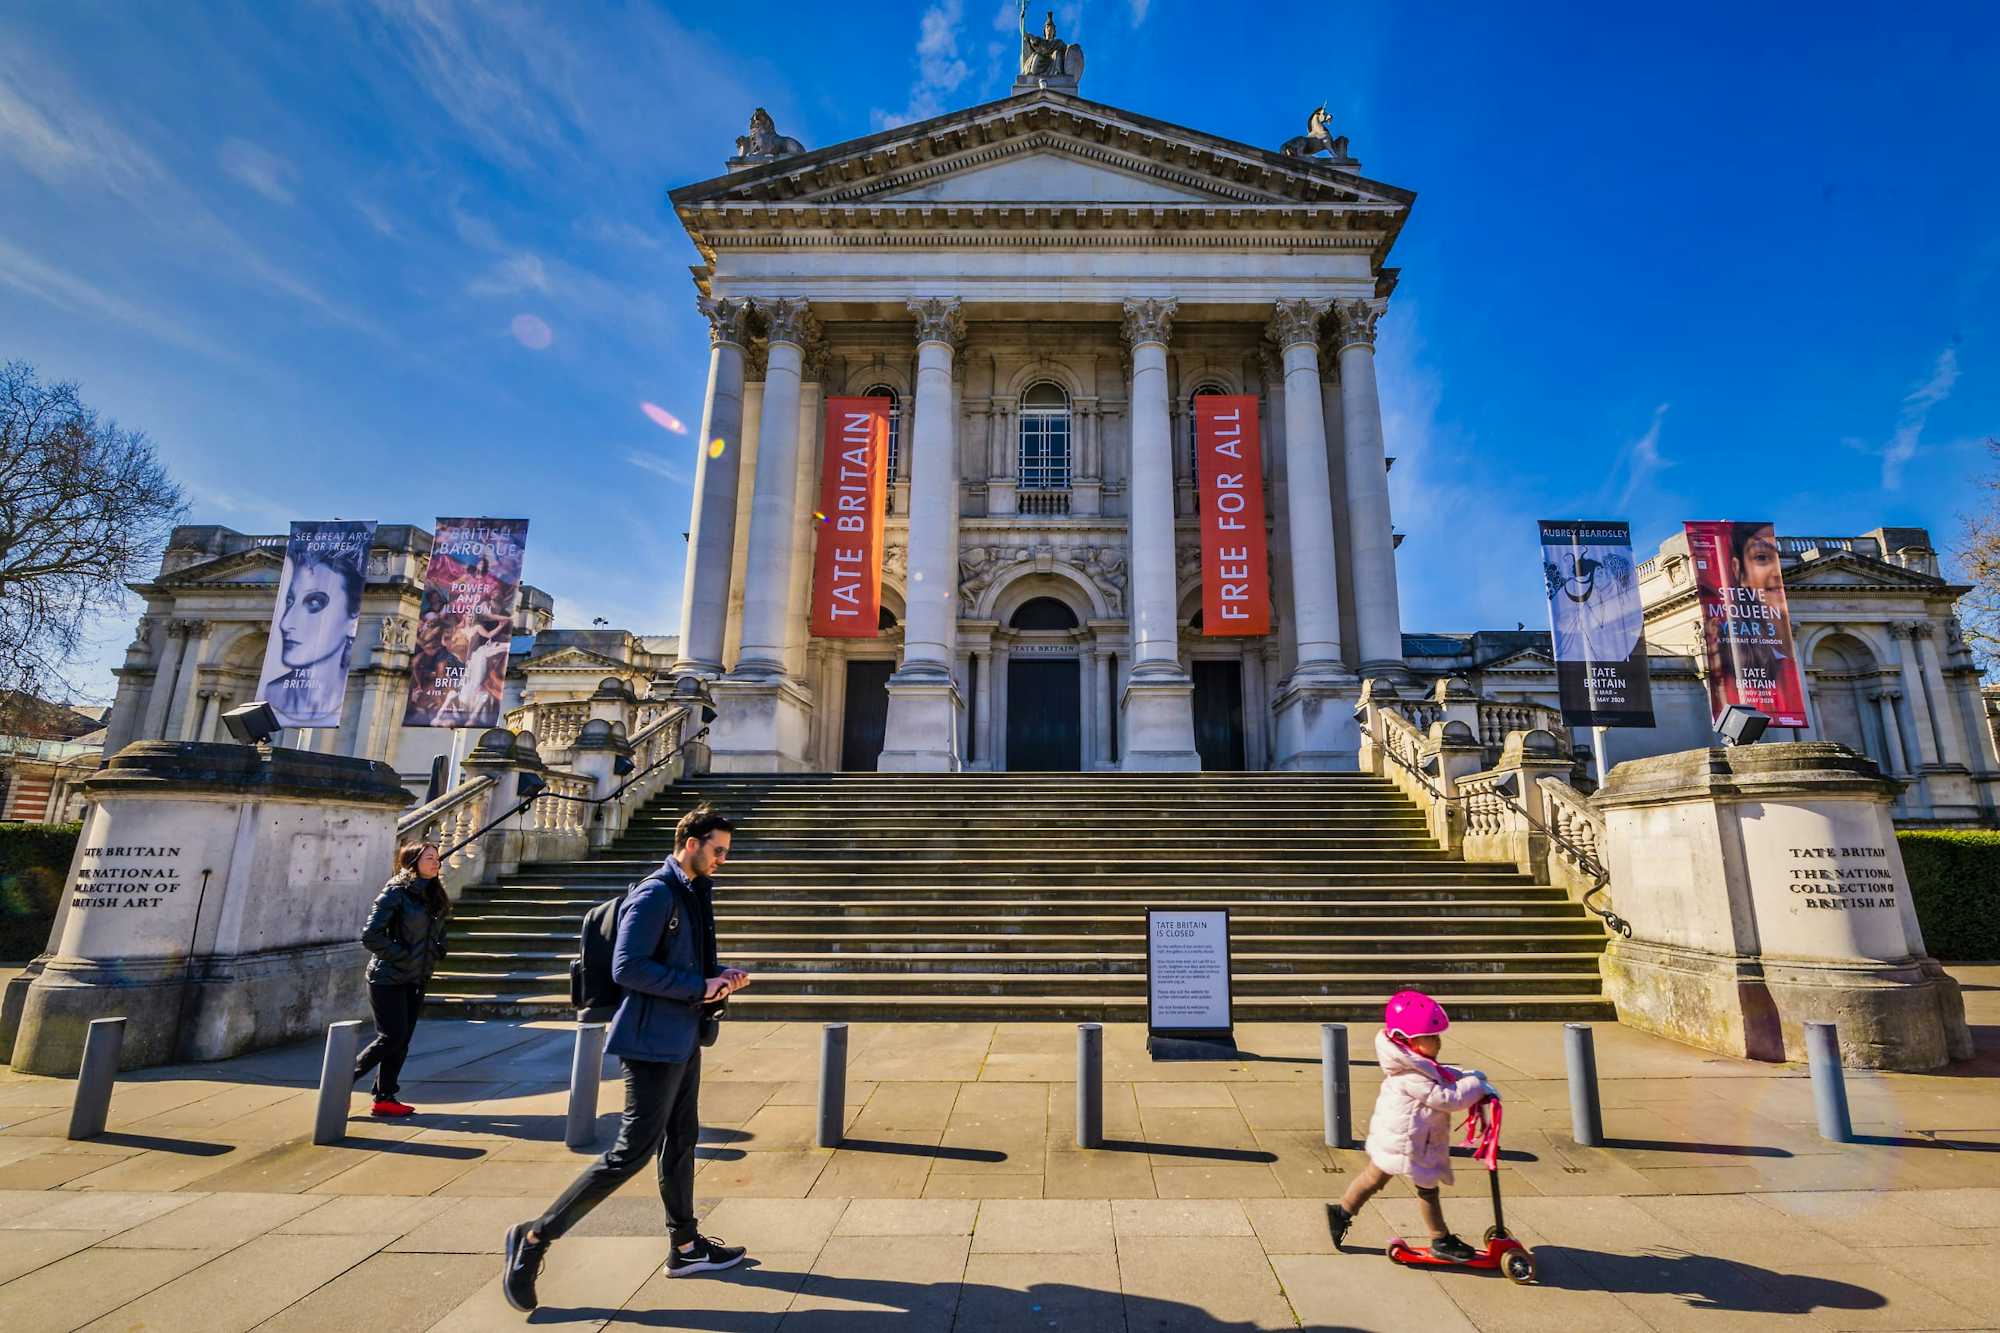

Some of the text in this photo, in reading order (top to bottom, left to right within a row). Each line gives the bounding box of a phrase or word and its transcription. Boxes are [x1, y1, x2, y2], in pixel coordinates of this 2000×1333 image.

[831, 413, 870, 620] TATE BRITAIN
[1213, 408, 1249, 620] FREE FOR ALL
[295, 532, 312, 541] SEE
[314, 531, 346, 541] GREAT
[449, 526, 512, 540] BRITISH
[1542, 528, 1628, 538] AUBREY BEARDSLEY
[306, 542, 327, 551] FOR
[439, 542, 517, 557] BAROQUE
[451, 582, 490, 593] POWER
[456, 593, 481, 603] AND
[1718, 587, 1767, 602] STEVE
[442, 603, 492, 614] ILLUSION
[1720, 620, 1777, 637] YEAR 3
[295, 668, 313, 679] TAT
[1592, 667, 1616, 677] TATE
[1743, 667, 1767, 678] TATE
[435, 677, 471, 689] BRITA
[1583, 678, 1627, 688] BRITAIN
[1736, 679, 1777, 689] BRITAIN
[84, 846, 182, 857] ATE BRITAIN
[1789, 847, 1837, 858] TATE
[92, 868, 179, 879] NATIONAL
[1790, 868, 1833, 880] THE
[154, 882, 181, 893] OF
[1789, 883, 1887, 894] COLLECTION
[123, 897, 163, 908] ART
[1805, 898, 1876, 910] BRITISH
[1156, 921, 1207, 929] TATE BRITAIN
[1156, 929, 1195, 938] IS CLOSED
